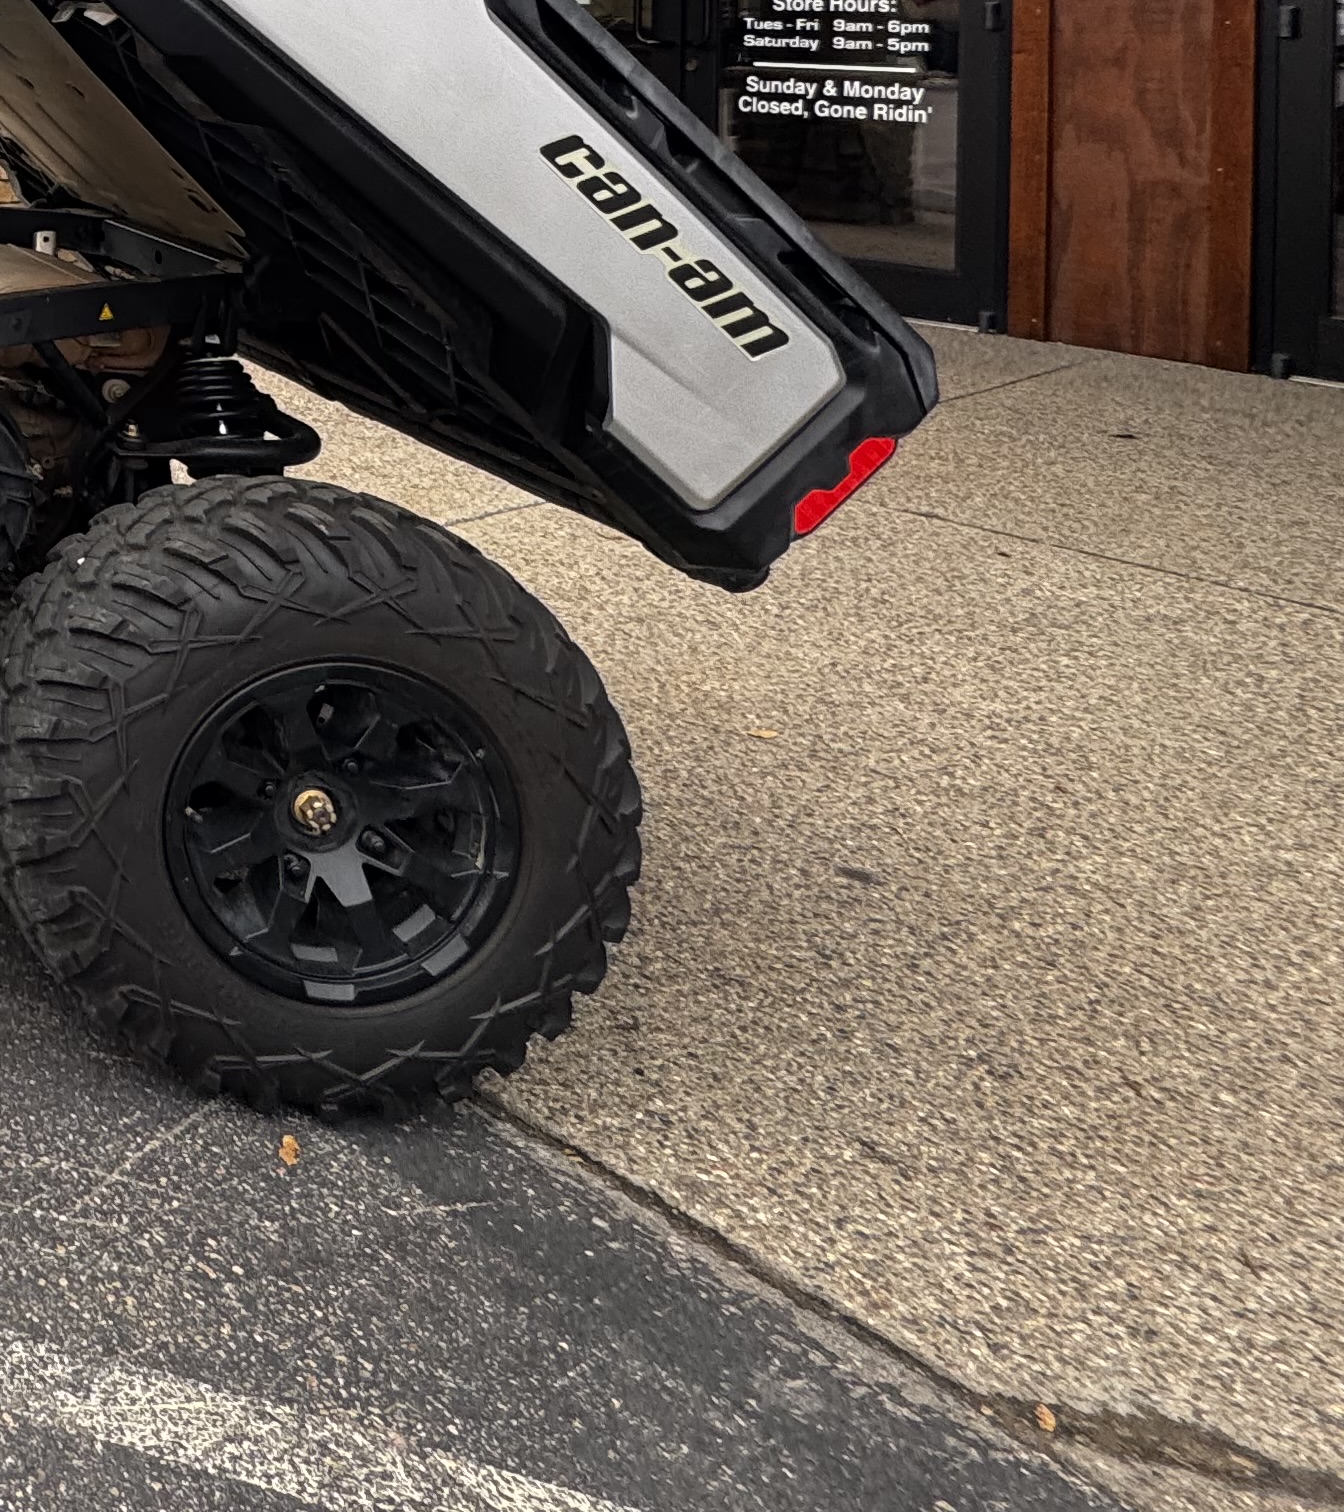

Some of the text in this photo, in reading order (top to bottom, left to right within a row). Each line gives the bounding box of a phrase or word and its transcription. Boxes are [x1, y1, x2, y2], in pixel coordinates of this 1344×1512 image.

[743, 17, 783, 30] Tues
[795, 18, 819, 31] Fri
[832, 19, 873, 32] 9am
[887, 20, 930, 36] 6pm
[743, 34, 819, 51] Saturday
[832, 37, 873, 50] 9am
[887, 38, 929, 54] 5pm
[745, 76, 925, 105] Sunday & Monday
[738, 96, 933, 123] Closed, Gone Ridin'
[540, 134, 790, 359] can-am
